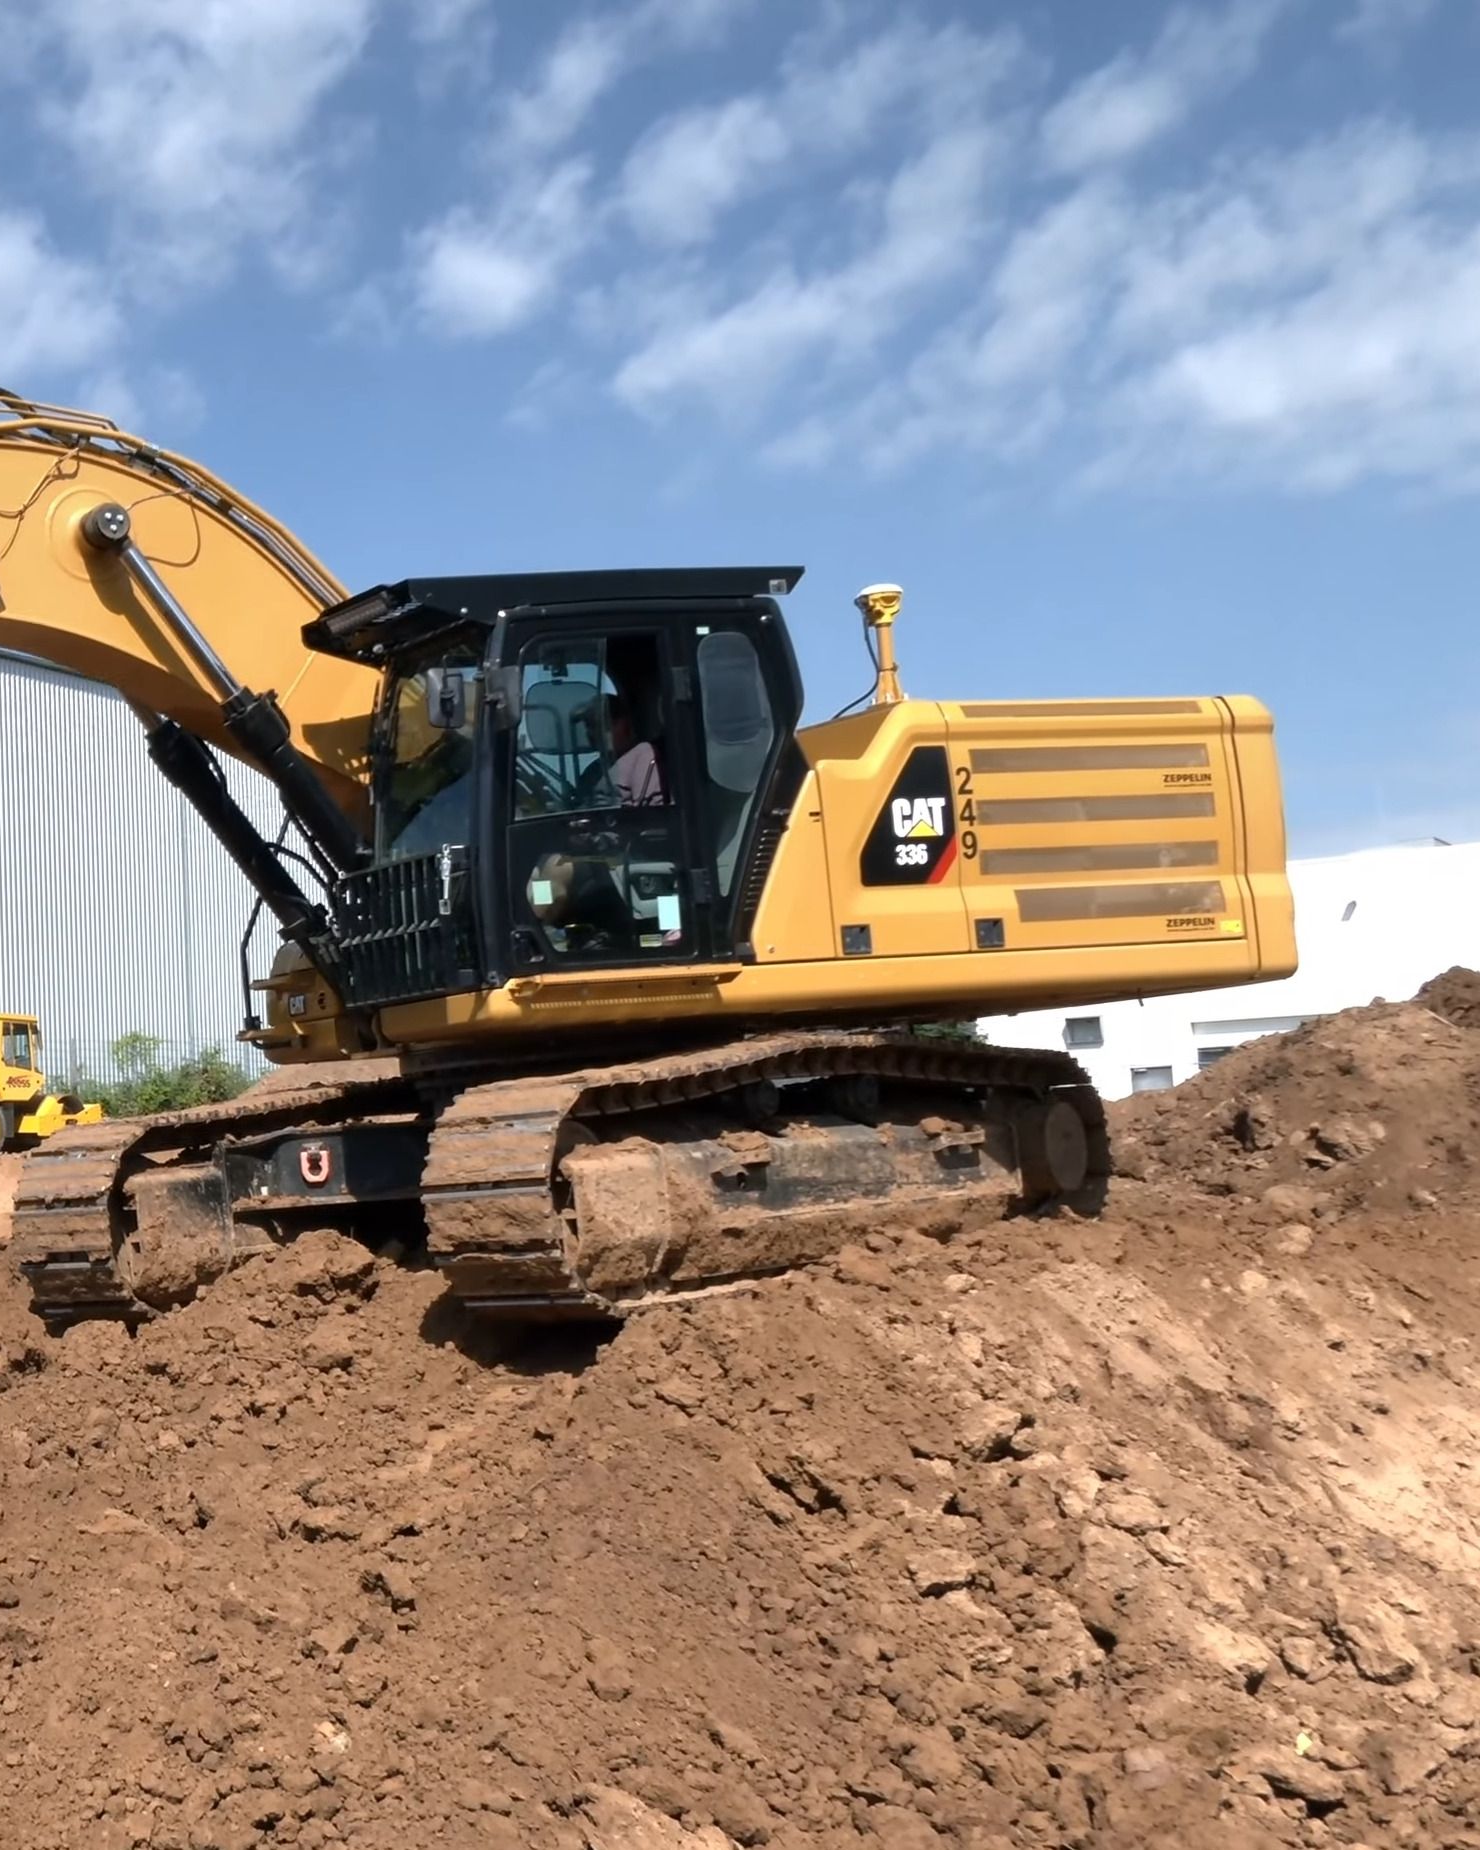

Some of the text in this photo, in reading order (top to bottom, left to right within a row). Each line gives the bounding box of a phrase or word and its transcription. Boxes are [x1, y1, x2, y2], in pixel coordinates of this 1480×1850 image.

[1162, 773, 1212, 783] ZEPPELIN
[891, 797, 946, 838] CAT
[895, 844, 928, 865] 336
[1166, 917, 1216, 928] ZEPPELIN
